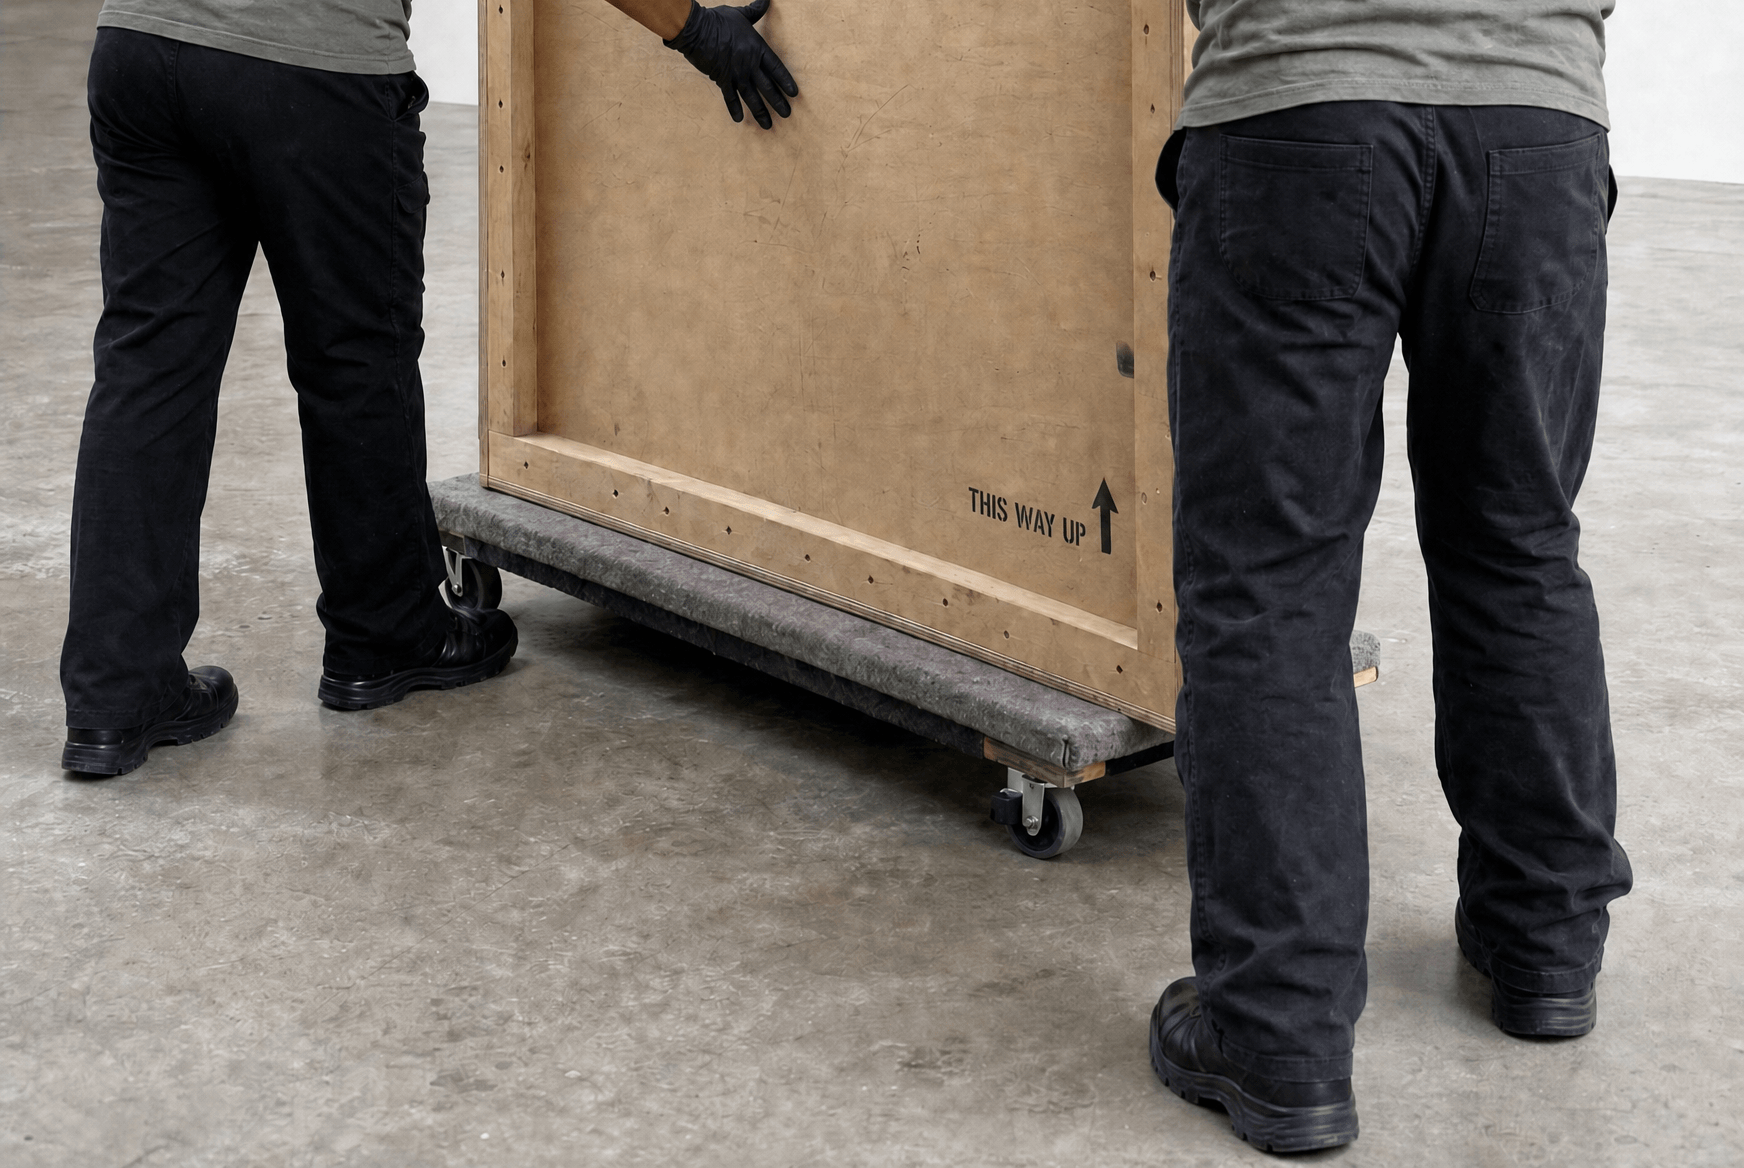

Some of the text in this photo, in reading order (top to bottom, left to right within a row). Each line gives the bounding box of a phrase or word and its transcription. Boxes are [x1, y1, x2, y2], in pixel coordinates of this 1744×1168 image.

[968, 486, 1087, 547] THIS WAY UP
